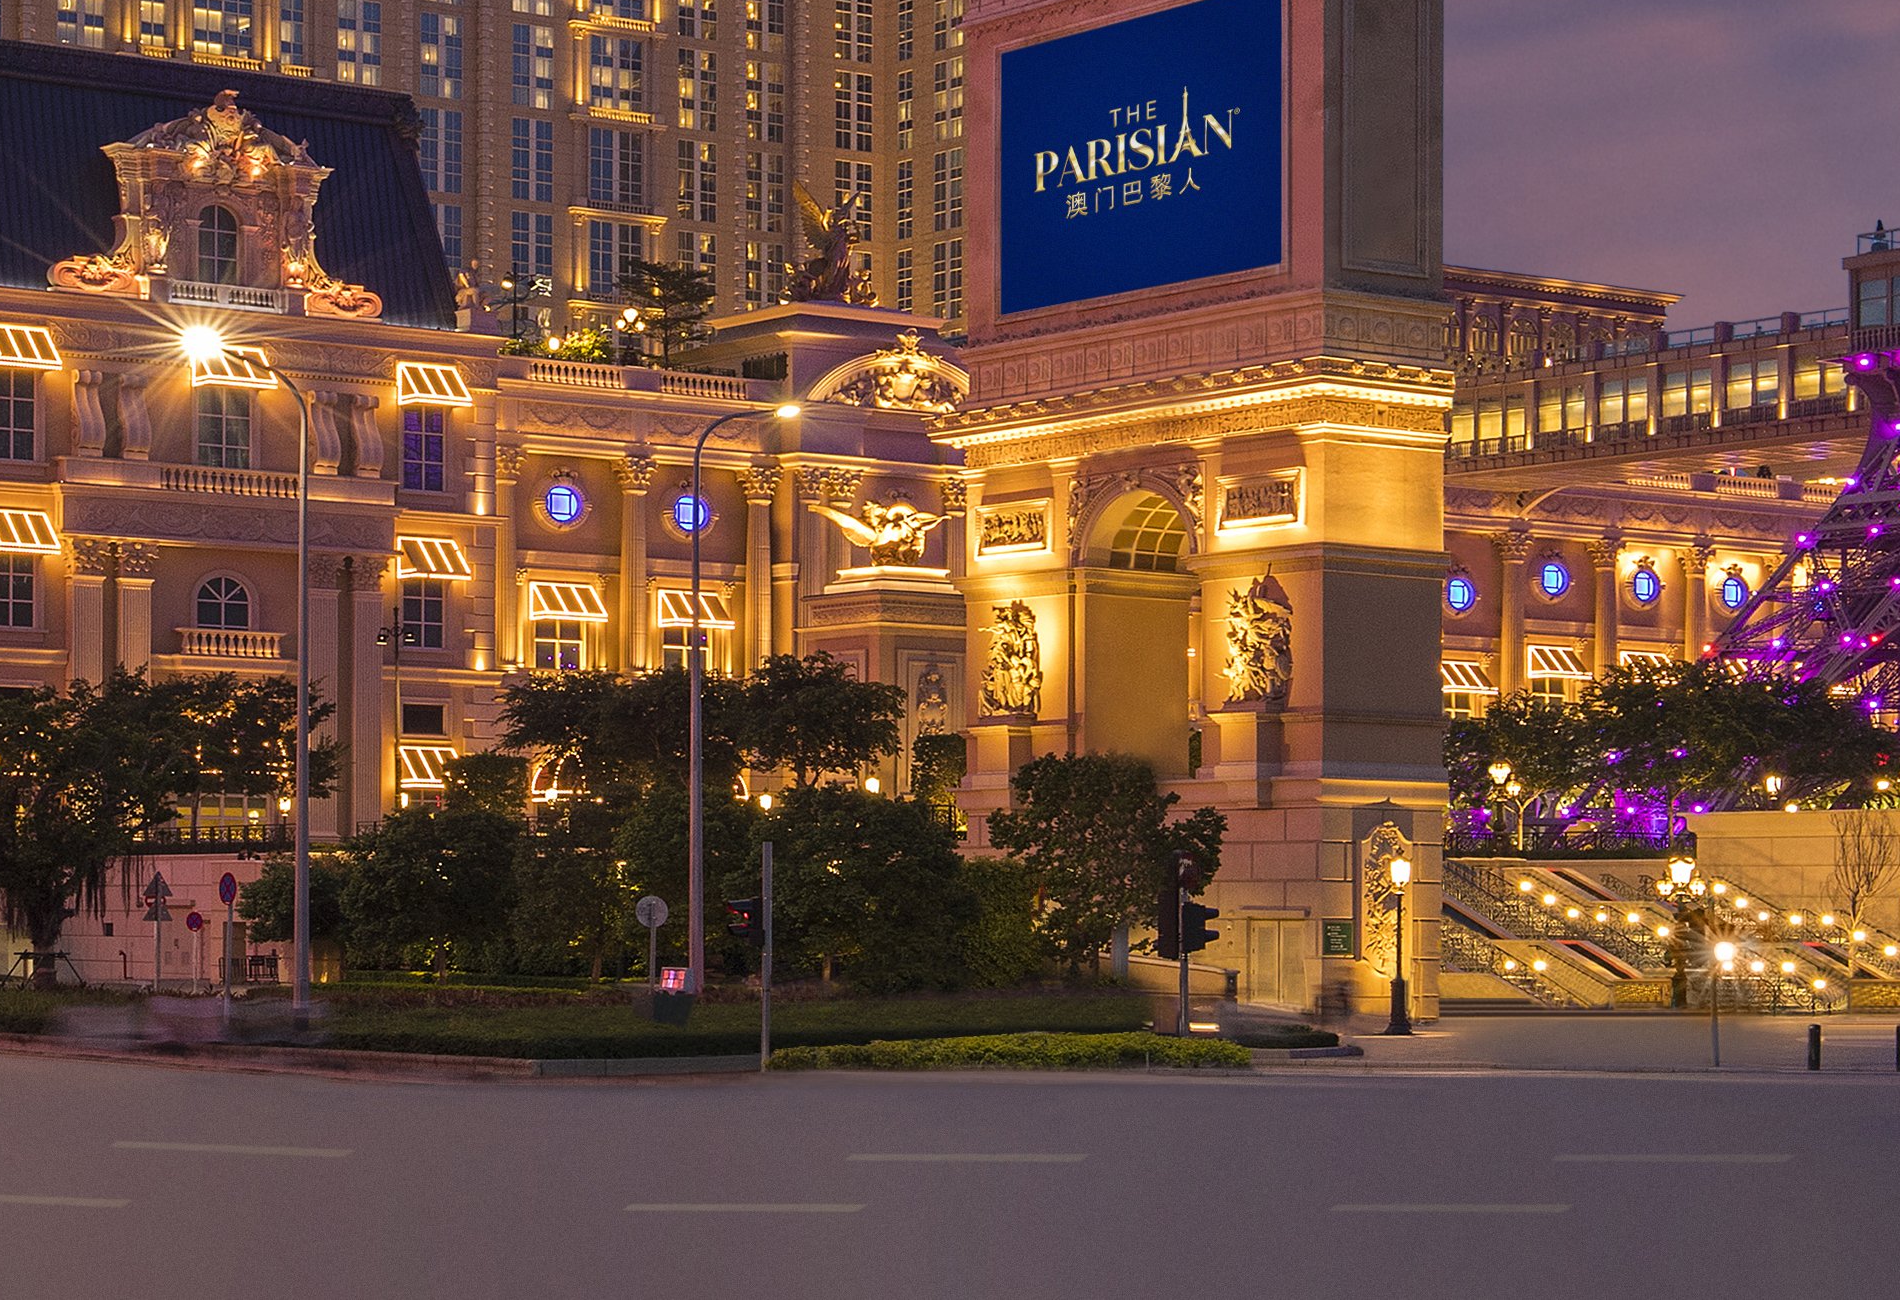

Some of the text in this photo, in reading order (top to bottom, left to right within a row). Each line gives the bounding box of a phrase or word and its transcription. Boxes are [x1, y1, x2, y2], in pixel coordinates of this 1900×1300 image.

[1109, 100, 1157, 128] THE
[1065, 167, 1201, 220] 澳门巴黎人
